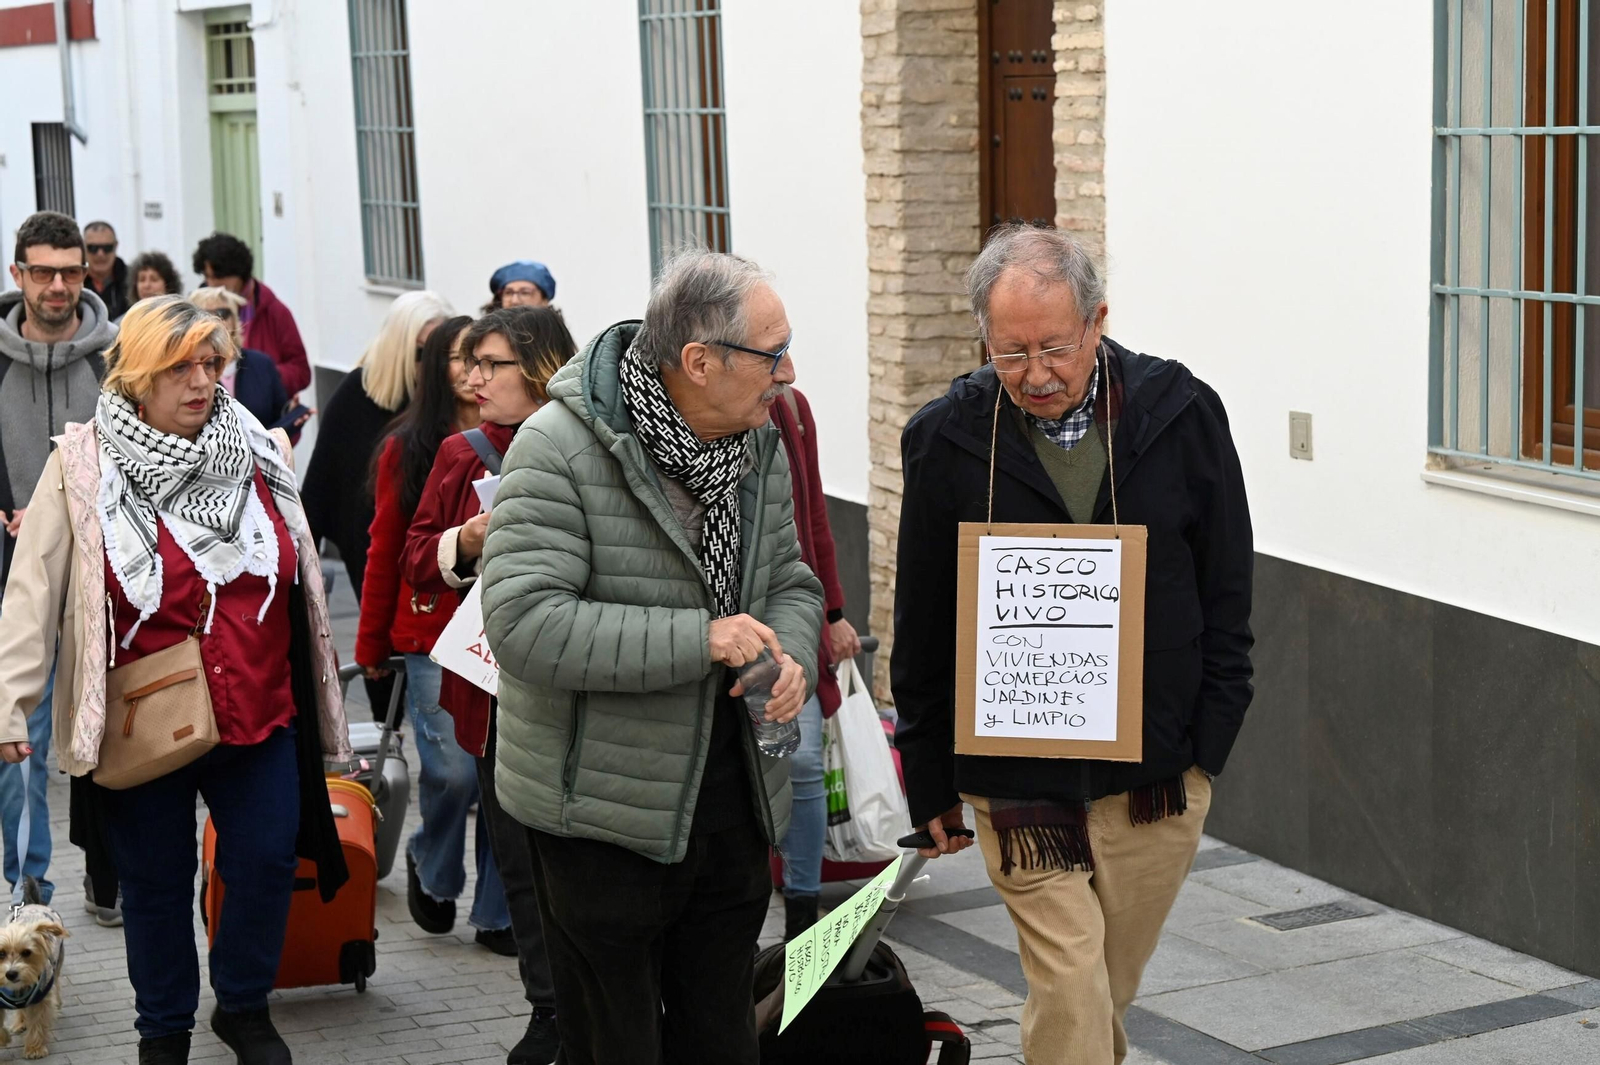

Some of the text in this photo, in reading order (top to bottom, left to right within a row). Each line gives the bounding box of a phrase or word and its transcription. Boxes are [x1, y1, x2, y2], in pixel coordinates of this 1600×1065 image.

[996, 554, 1097, 576] CASCO
[996, 604, 1067, 622] VIVO
[992, 633, 1043, 649] CON
[986, 650, 1109, 669] VIVIENDAS
[982, 688, 1086, 706] JARDINES
[1012, 709, 1086, 728] LIMPIO
